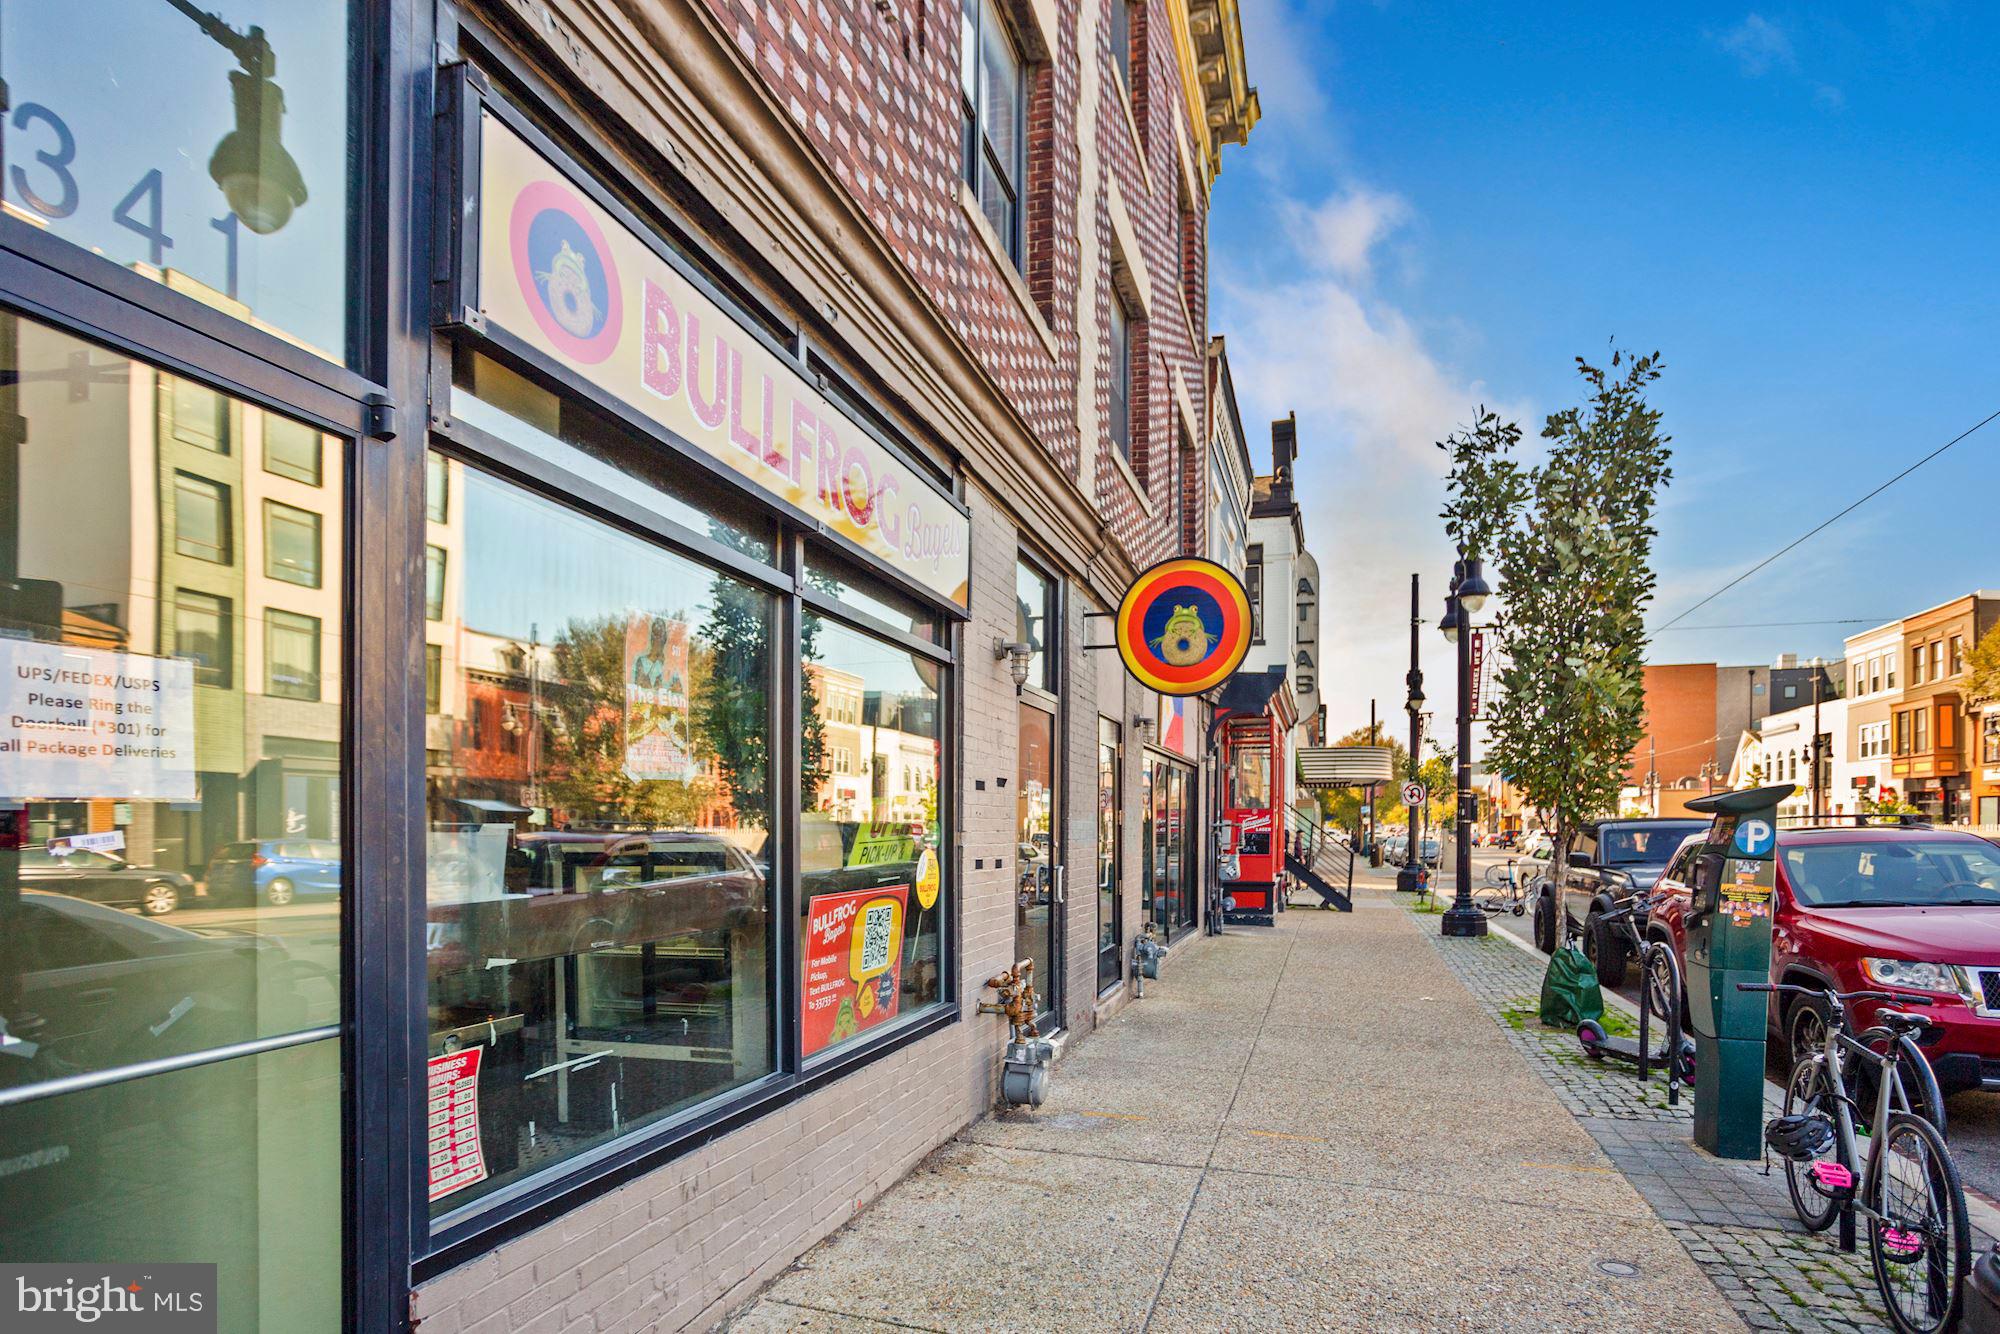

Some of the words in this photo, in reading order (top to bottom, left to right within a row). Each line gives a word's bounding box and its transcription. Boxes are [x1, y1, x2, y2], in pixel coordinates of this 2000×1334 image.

[641, 278, 900, 550] BULLFROG
[904, 502, 962, 573] Bagels
[1296, 577, 1315, 695] ATLAS
[17, 665, 161, 692] UPS/FEDEX/USPS
[28, 692, 83, 709] Please
[89, 697, 124, 715] Ring
[127, 701, 153, 714] the
[626, 682, 654, 704] The
[11, 715, 87, 733] Doorbell
[145, 725, 167, 737] for
[0, 739, 21, 753] all
[27, 740, 97, 759] Package
[102, 743, 177, 759] Deliveries
[1746, 822, 1771, 853] P
[858, 844, 898, 865] PICK-UP
[812, 899, 857, 935] BULLFROG
[822, 920, 847, 945] Bagels
[811, 959, 820, 968] For
[820, 954, 838, 966] Mobile
[809, 986, 821, 996] Text
[820, 978, 846, 993] BULLFROG
[808, 1001, 815, 1010] To
[456, 1078, 473, 1090] CLOSED
